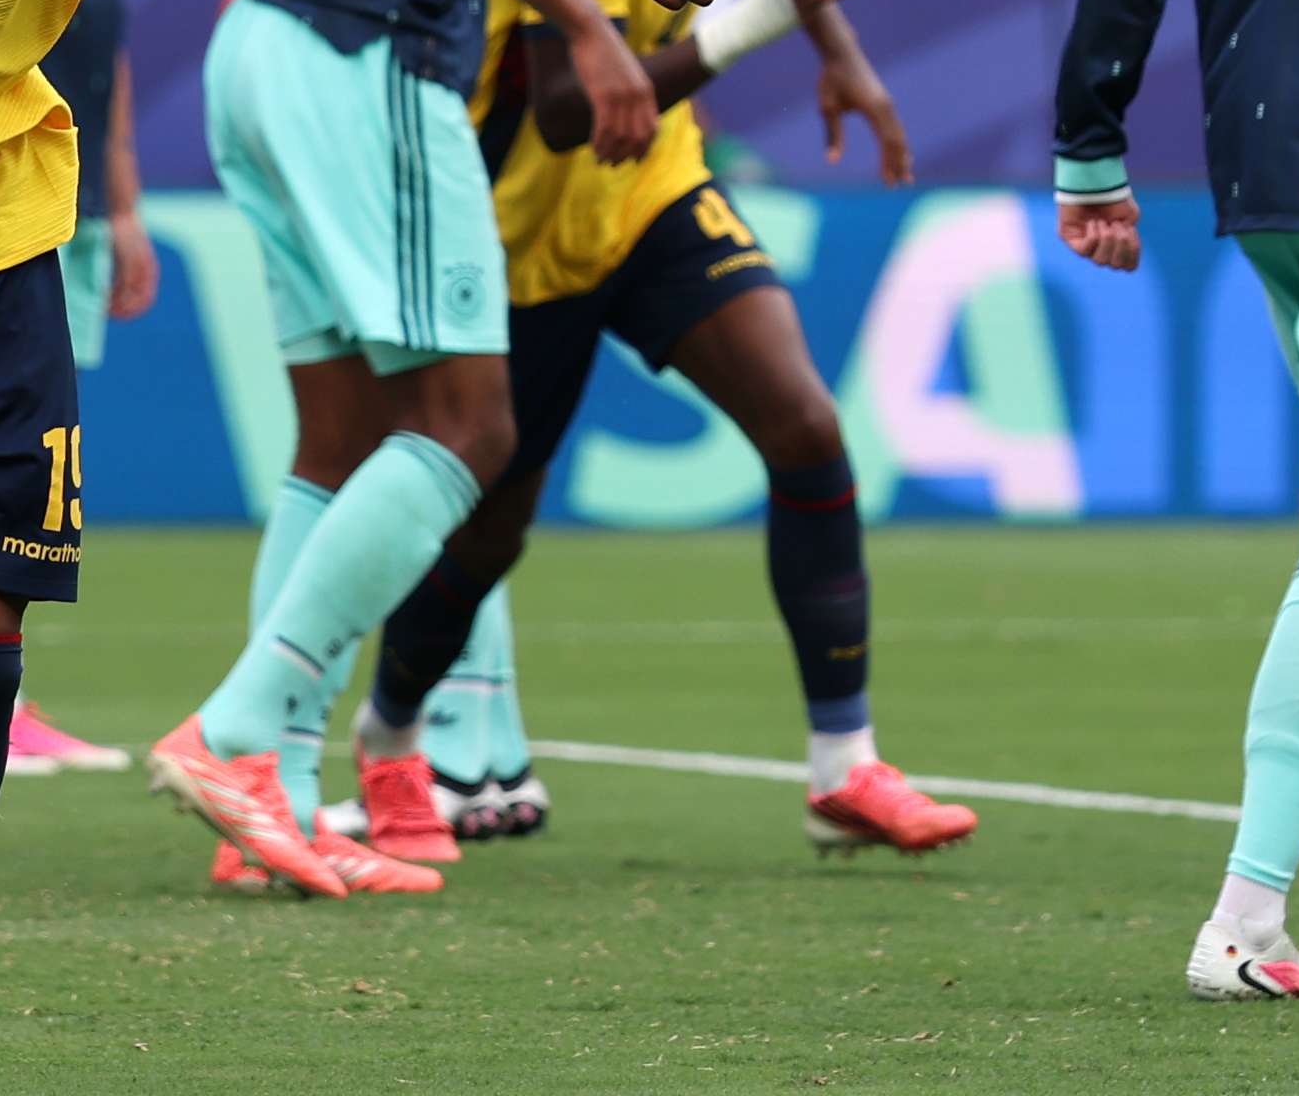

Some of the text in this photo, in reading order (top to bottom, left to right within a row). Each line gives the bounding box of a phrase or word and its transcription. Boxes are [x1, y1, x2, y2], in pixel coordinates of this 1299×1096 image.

[692, 187, 756, 247] 4
[139, 189, 1085, 526] VSA
[1, 535, 82, 564] maratho
